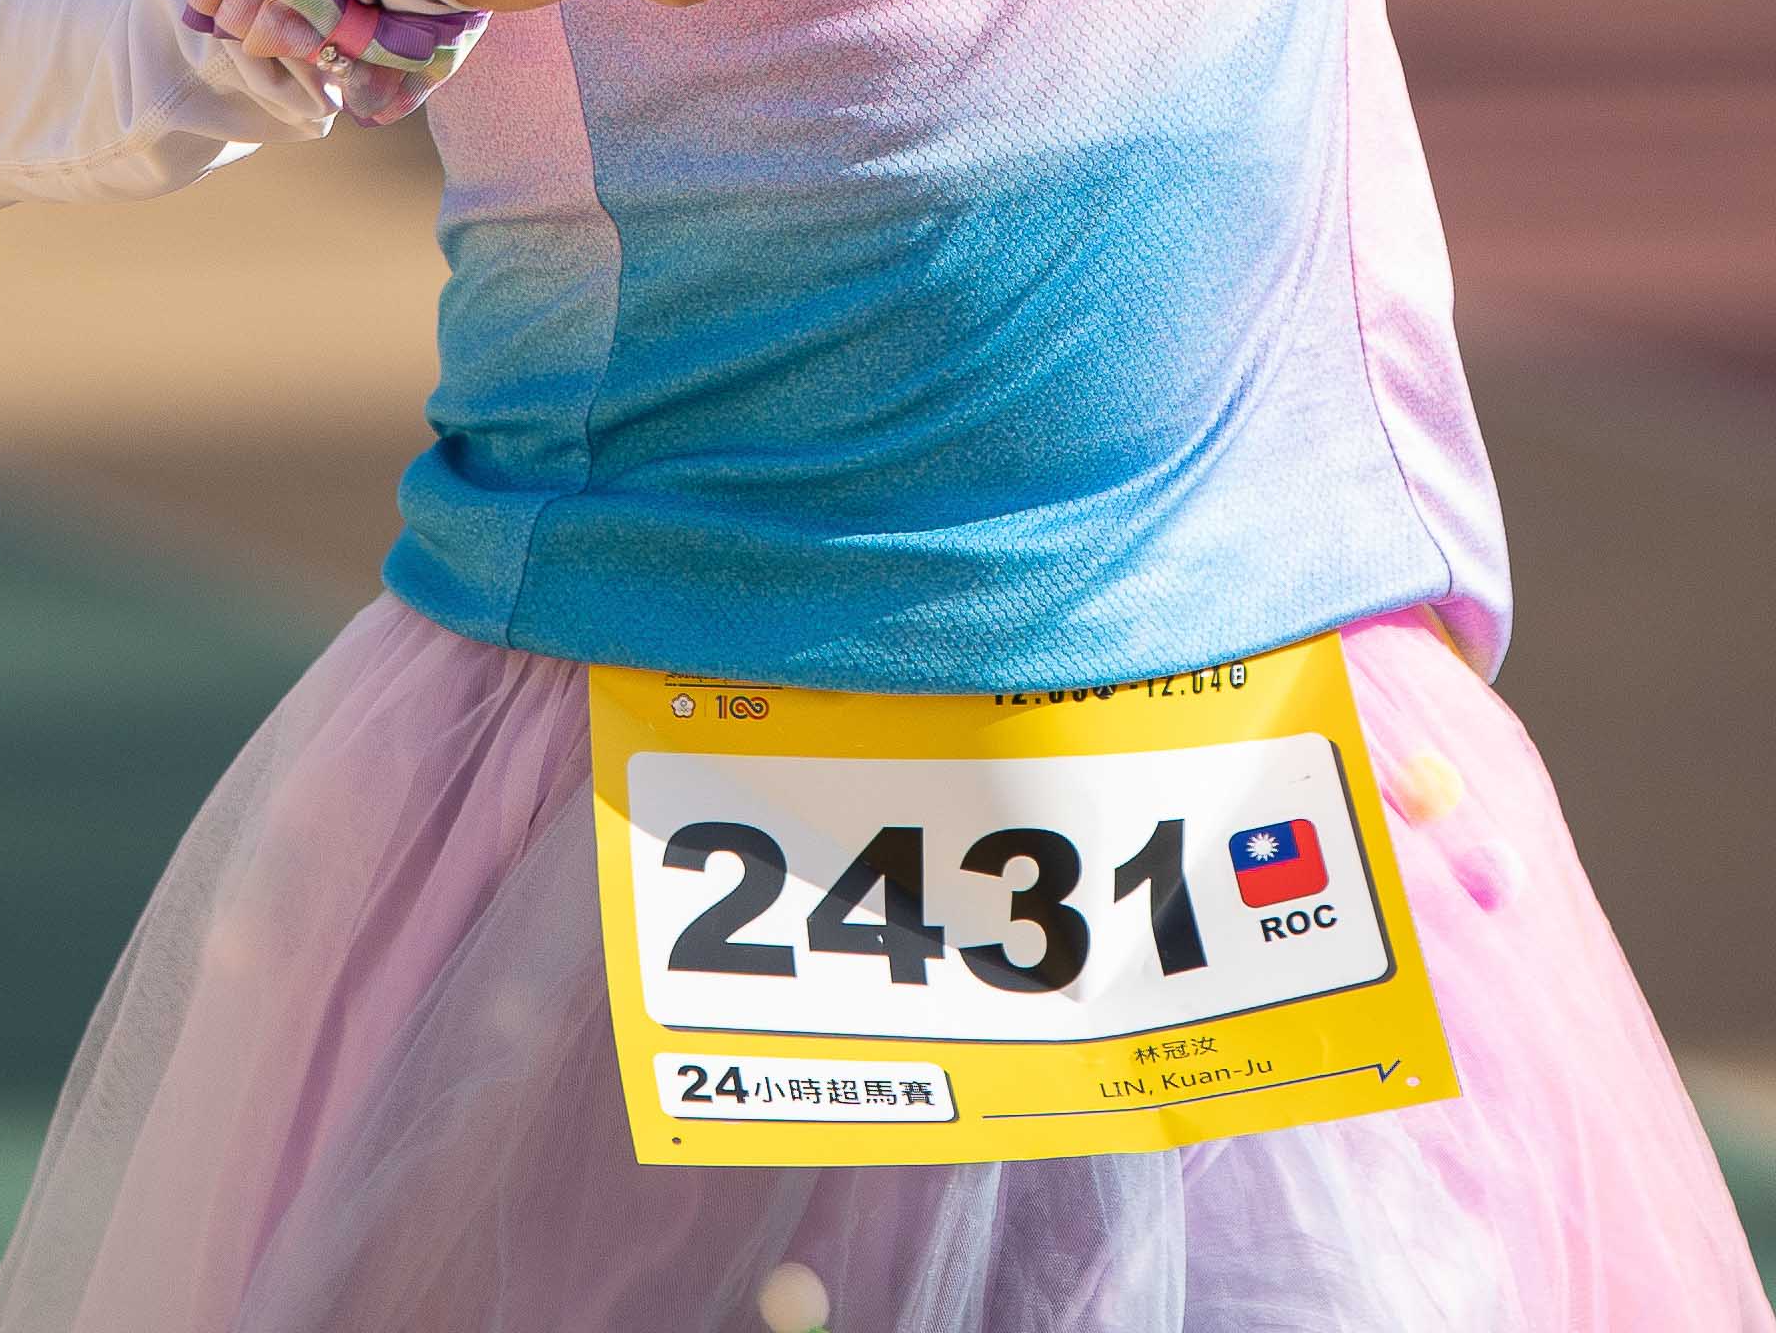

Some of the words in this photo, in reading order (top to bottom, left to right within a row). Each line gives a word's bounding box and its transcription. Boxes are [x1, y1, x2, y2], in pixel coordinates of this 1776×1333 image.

[662, 818, 1210, 995] 2431
[1259, 904, 1338, 943] ROC
[1134, 1036, 1219, 1066] 林冠汝
[676, 1063, 937, 1107] 24小時超馬賽
[1099, 1077, 1154, 1099] LIN,
[1161, 1058, 1274, 1091] Kuan-Ju
